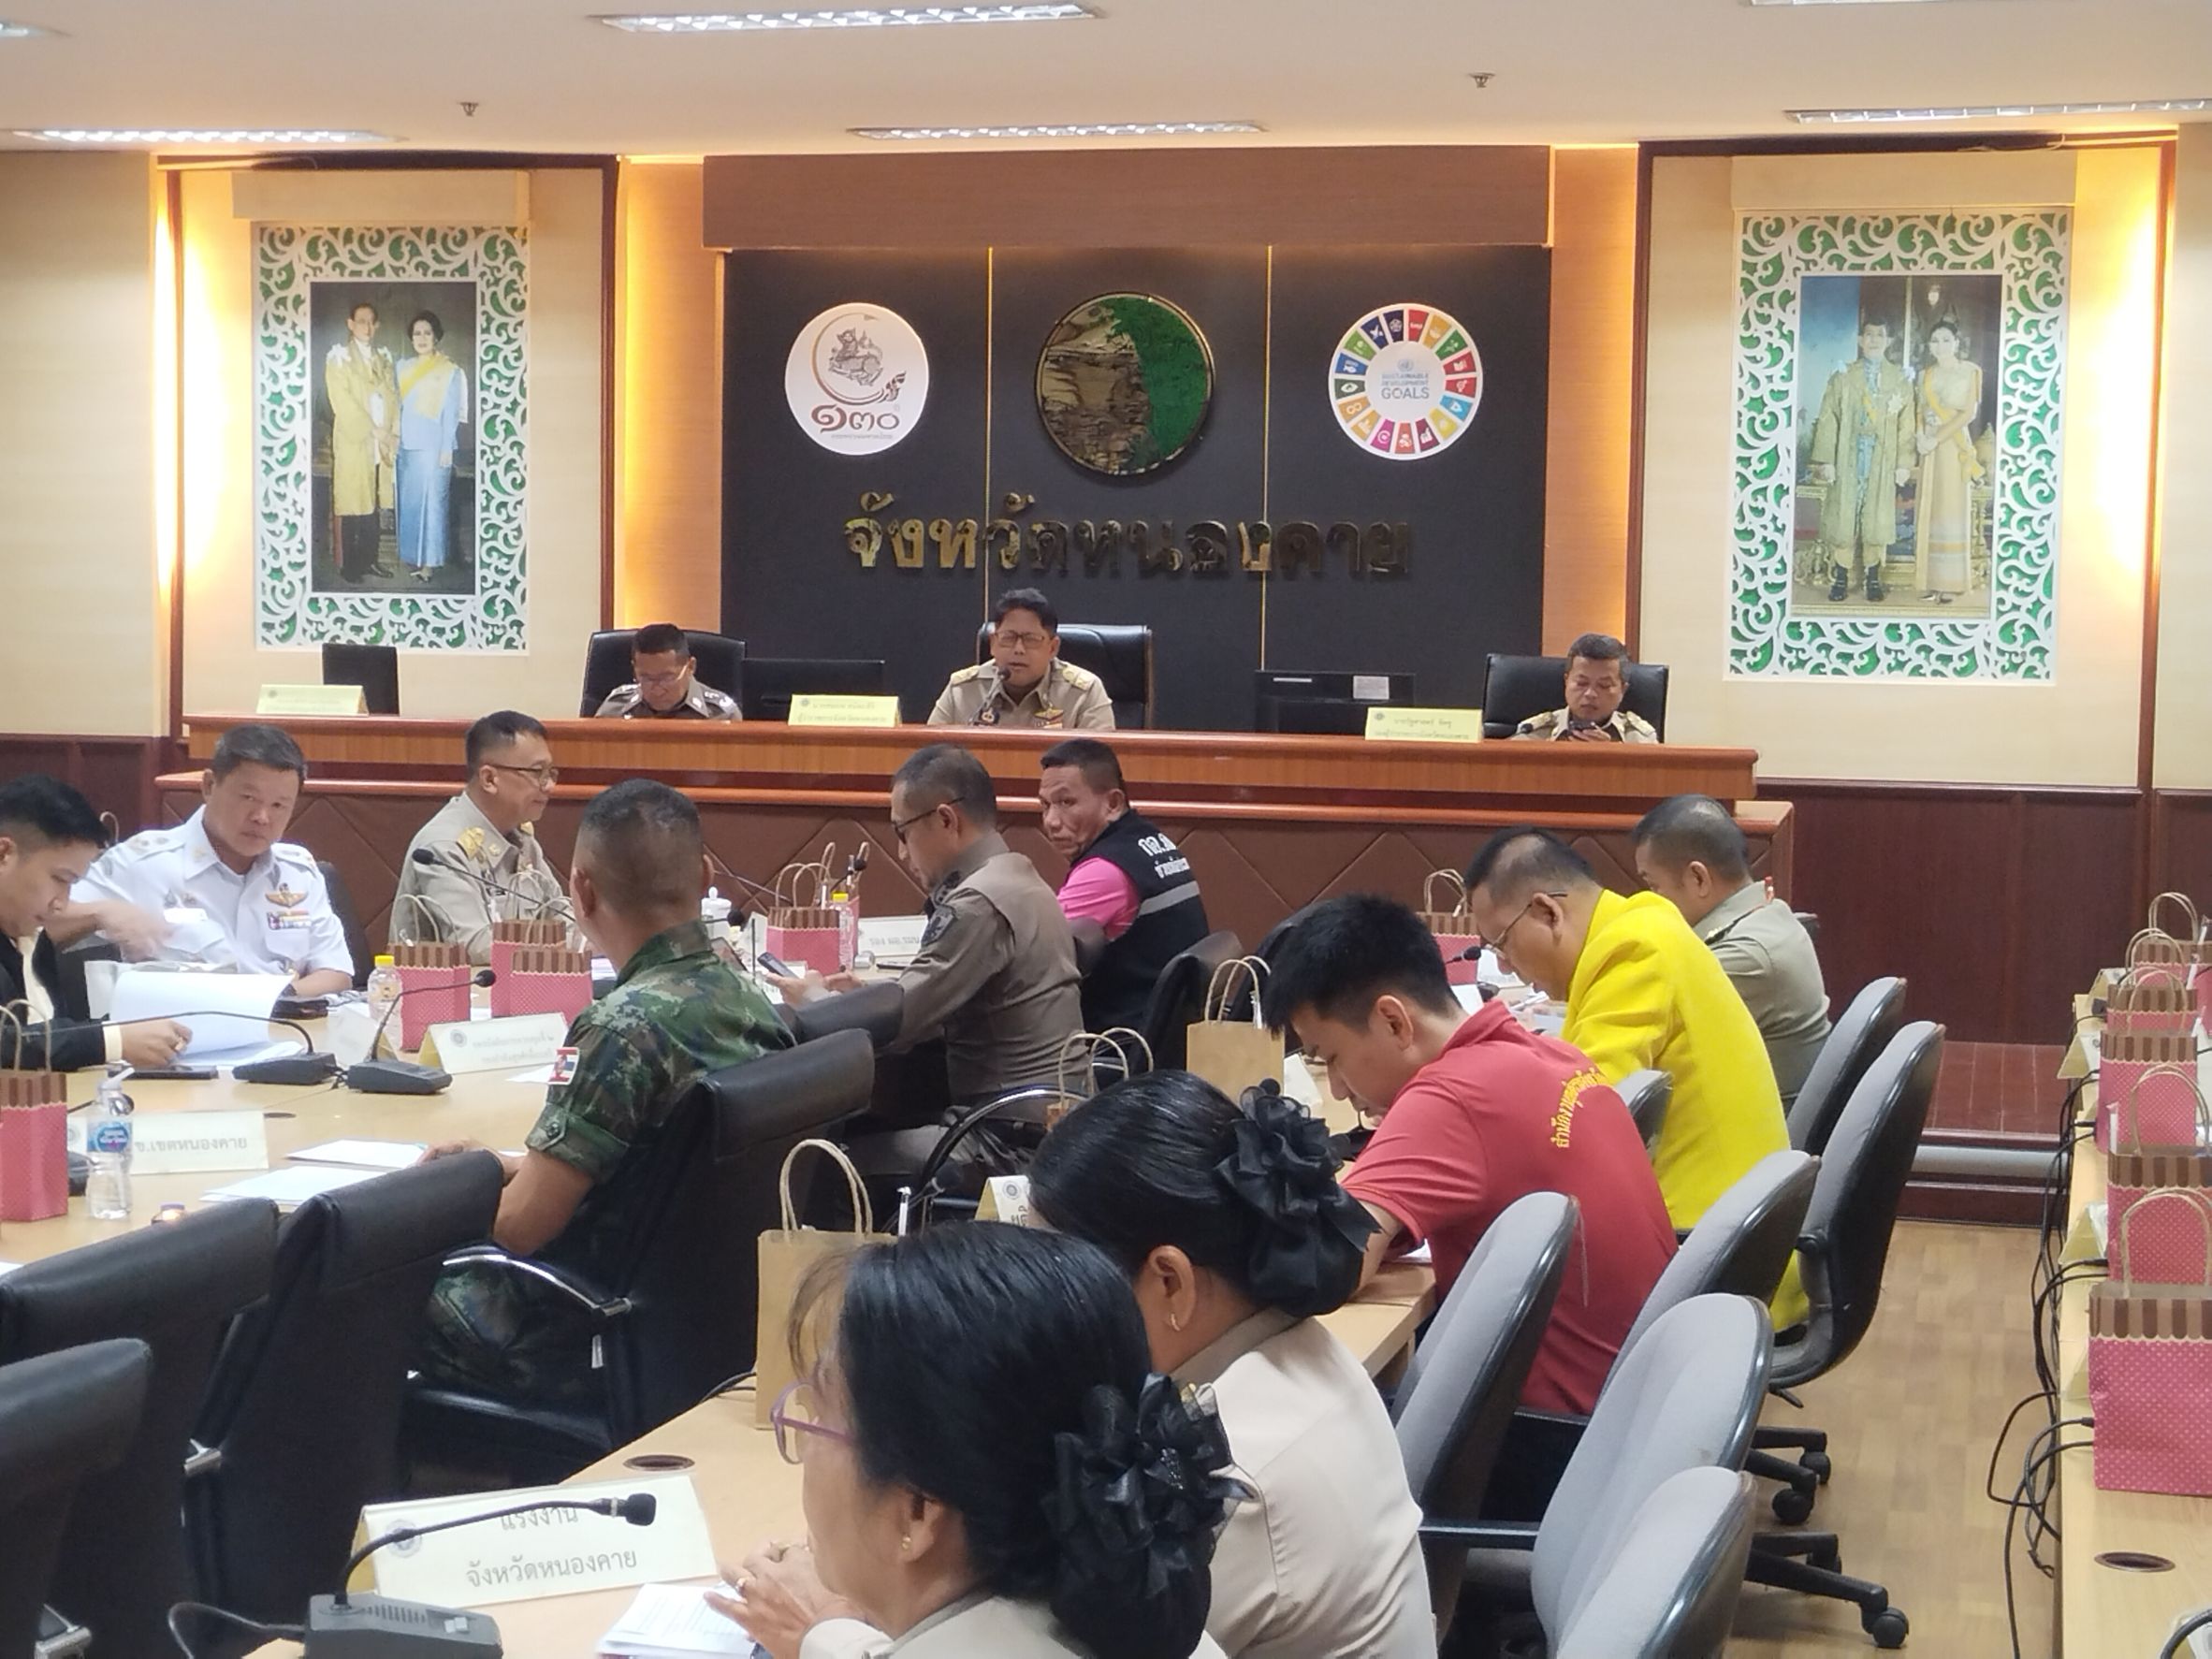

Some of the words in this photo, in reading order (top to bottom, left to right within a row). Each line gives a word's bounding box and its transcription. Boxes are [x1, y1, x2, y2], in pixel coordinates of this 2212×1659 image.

[1381, 387, 1430, 400] GOALS
[811, 404, 900, 433] ๑๓๐
[844, 492, 1409, 574] จังหวัดหนองคาย
[467, 1548, 638, 1589] จังหวัดหนองคาย
